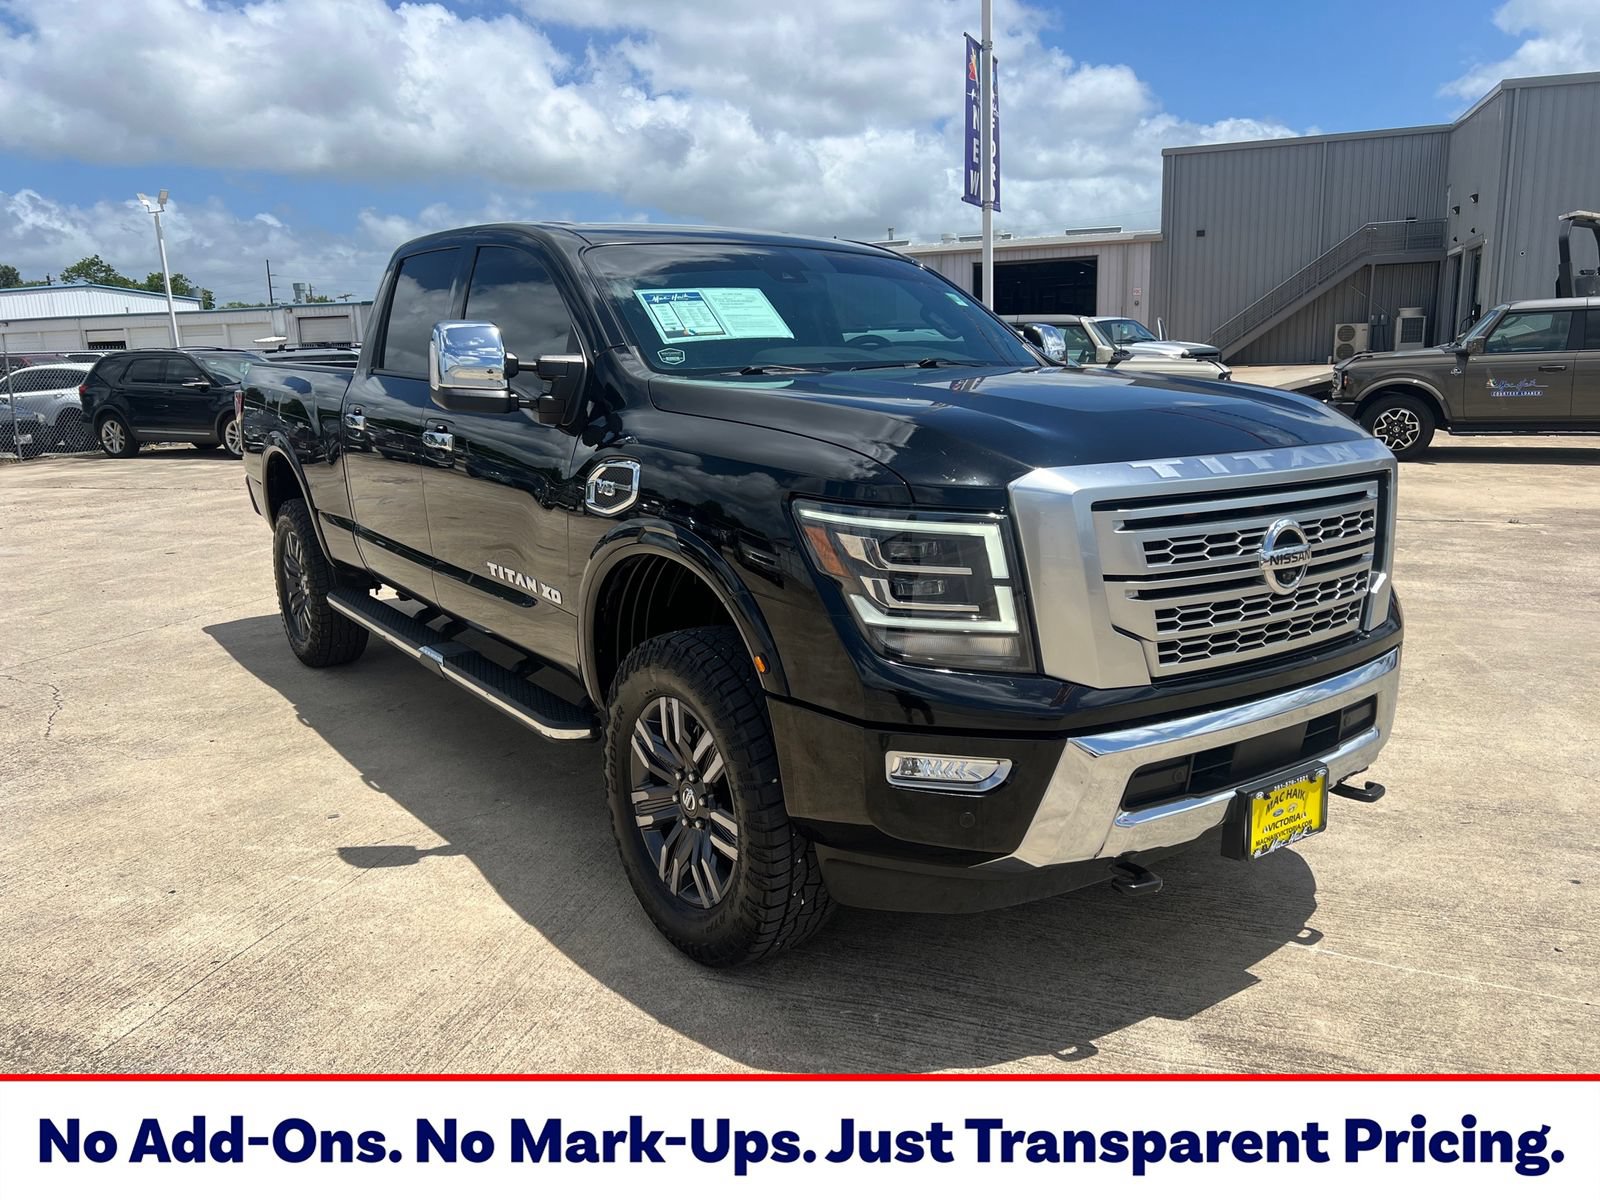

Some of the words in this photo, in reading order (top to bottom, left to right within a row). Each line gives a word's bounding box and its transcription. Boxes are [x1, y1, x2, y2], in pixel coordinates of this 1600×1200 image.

[970, 104, 980, 196] NEW
[1128, 445, 1361, 479] TITAN
[1269, 549, 1311, 566] NISSAN
[487, 561, 539, 594] TITAN
[540, 582, 563, 605] XD
[608, 704, 626, 794] COOPER
[1266, 791, 1284, 812] MAC
[1286, 788, 1305, 801] HAIK
[1268, 813, 1301, 831] VICTORIA
